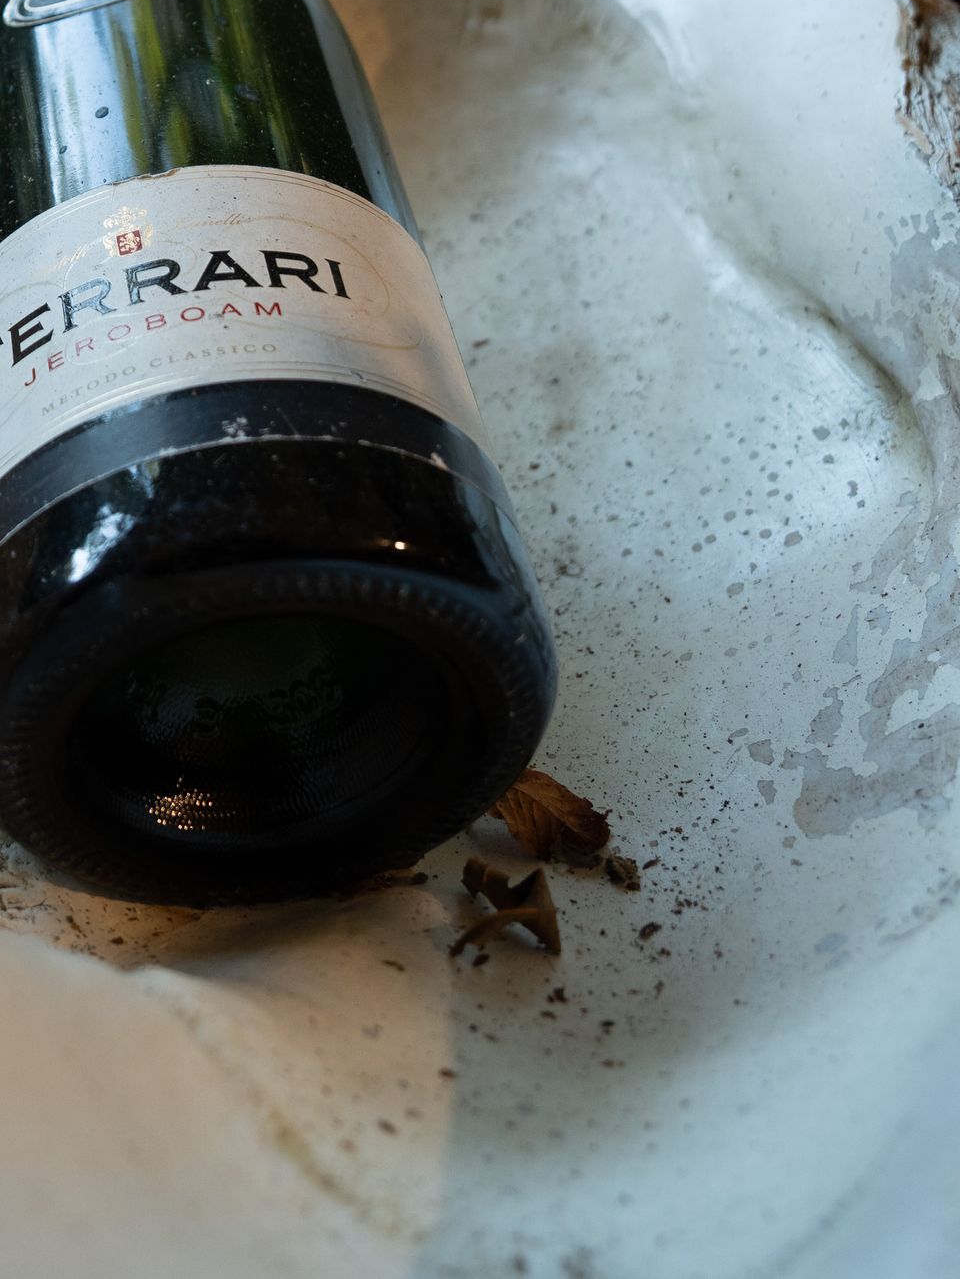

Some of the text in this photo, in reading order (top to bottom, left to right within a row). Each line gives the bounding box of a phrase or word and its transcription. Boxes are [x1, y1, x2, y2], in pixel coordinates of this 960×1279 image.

[24, 301, 283, 387] JEROBOAM
[40, 343, 277, 417] METODO CLASSICO
